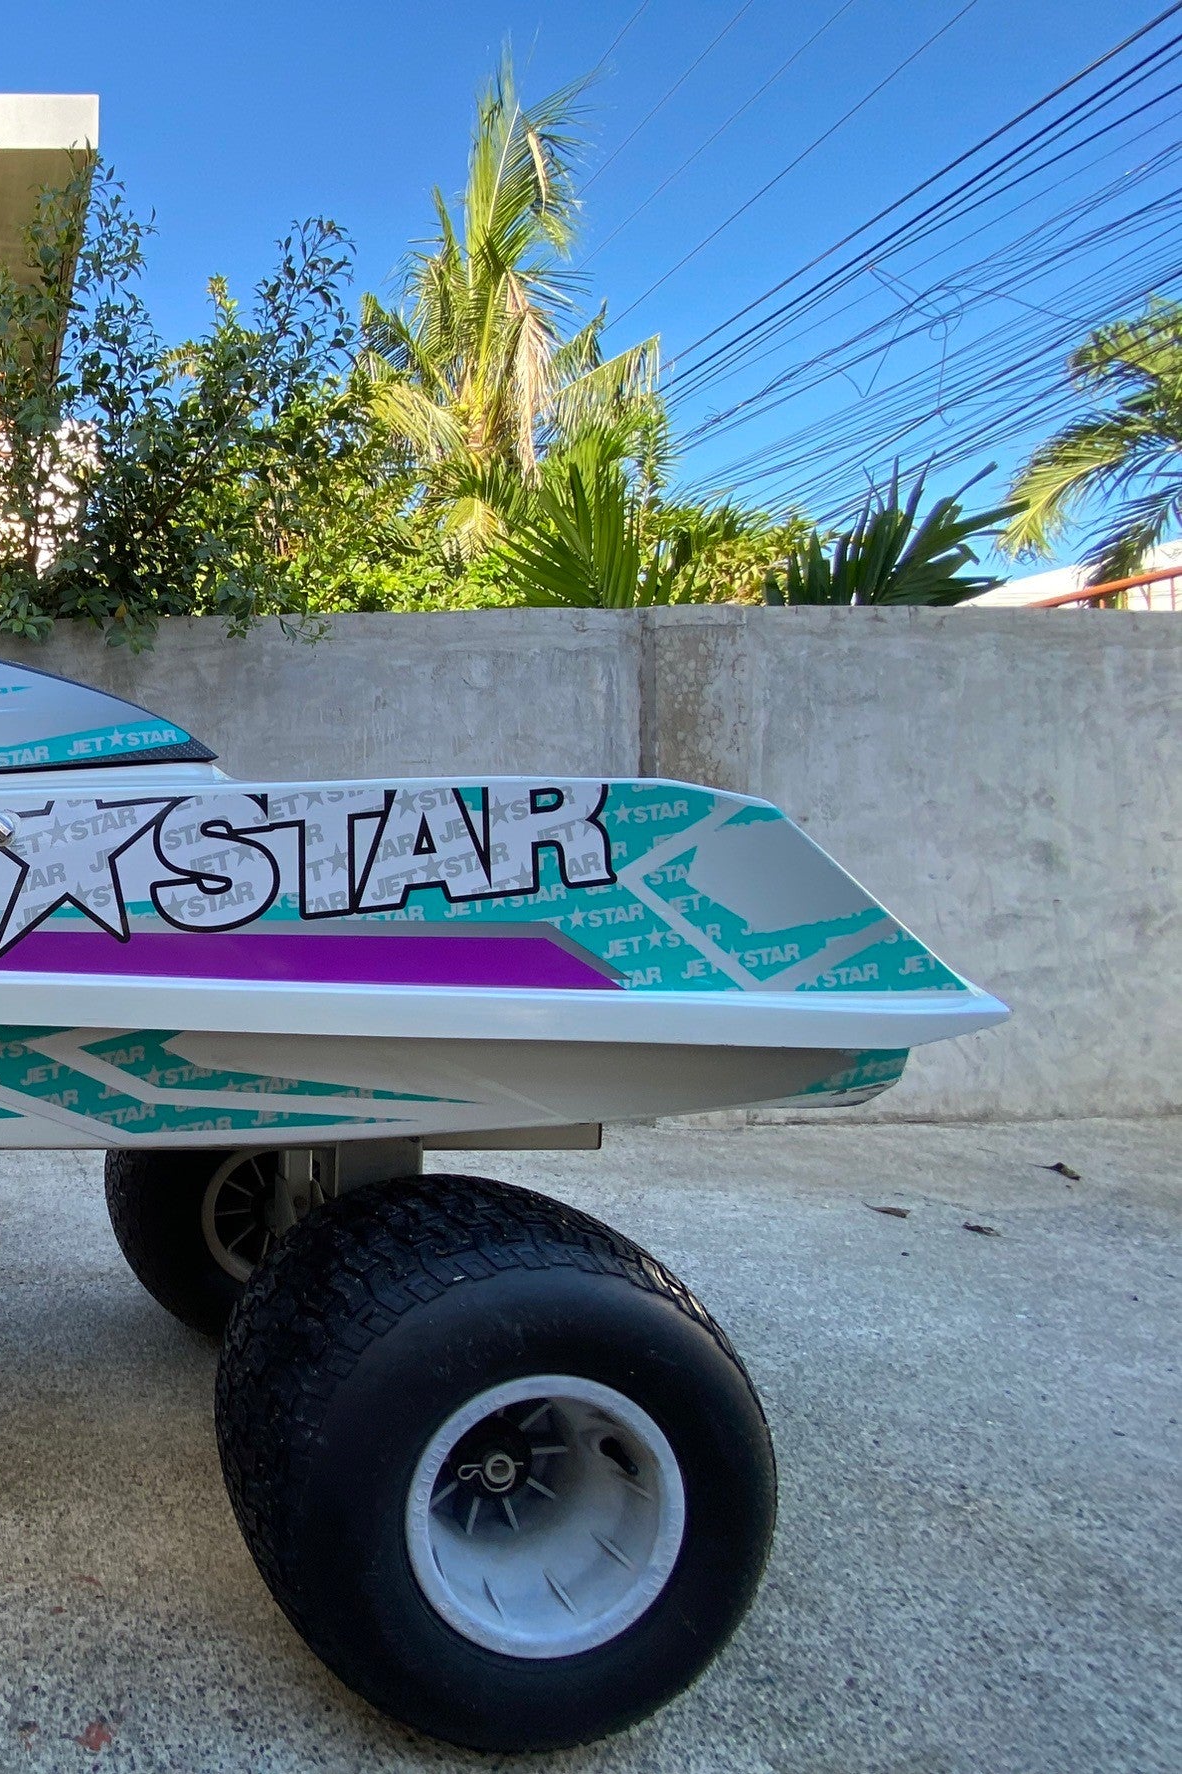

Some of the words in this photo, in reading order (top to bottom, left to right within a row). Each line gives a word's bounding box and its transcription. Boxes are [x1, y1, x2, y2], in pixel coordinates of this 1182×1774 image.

[67, 738, 103, 755] JET
[125, 730, 177, 746] STAR
[633, 800, 689, 823] STAR
[70, 807, 137, 842] STAR
[150, 784, 617, 933] STAR
[588, 904, 644, 927] STAR
[603, 937, 643, 958] JET
[822, 964, 879, 988] STAR
